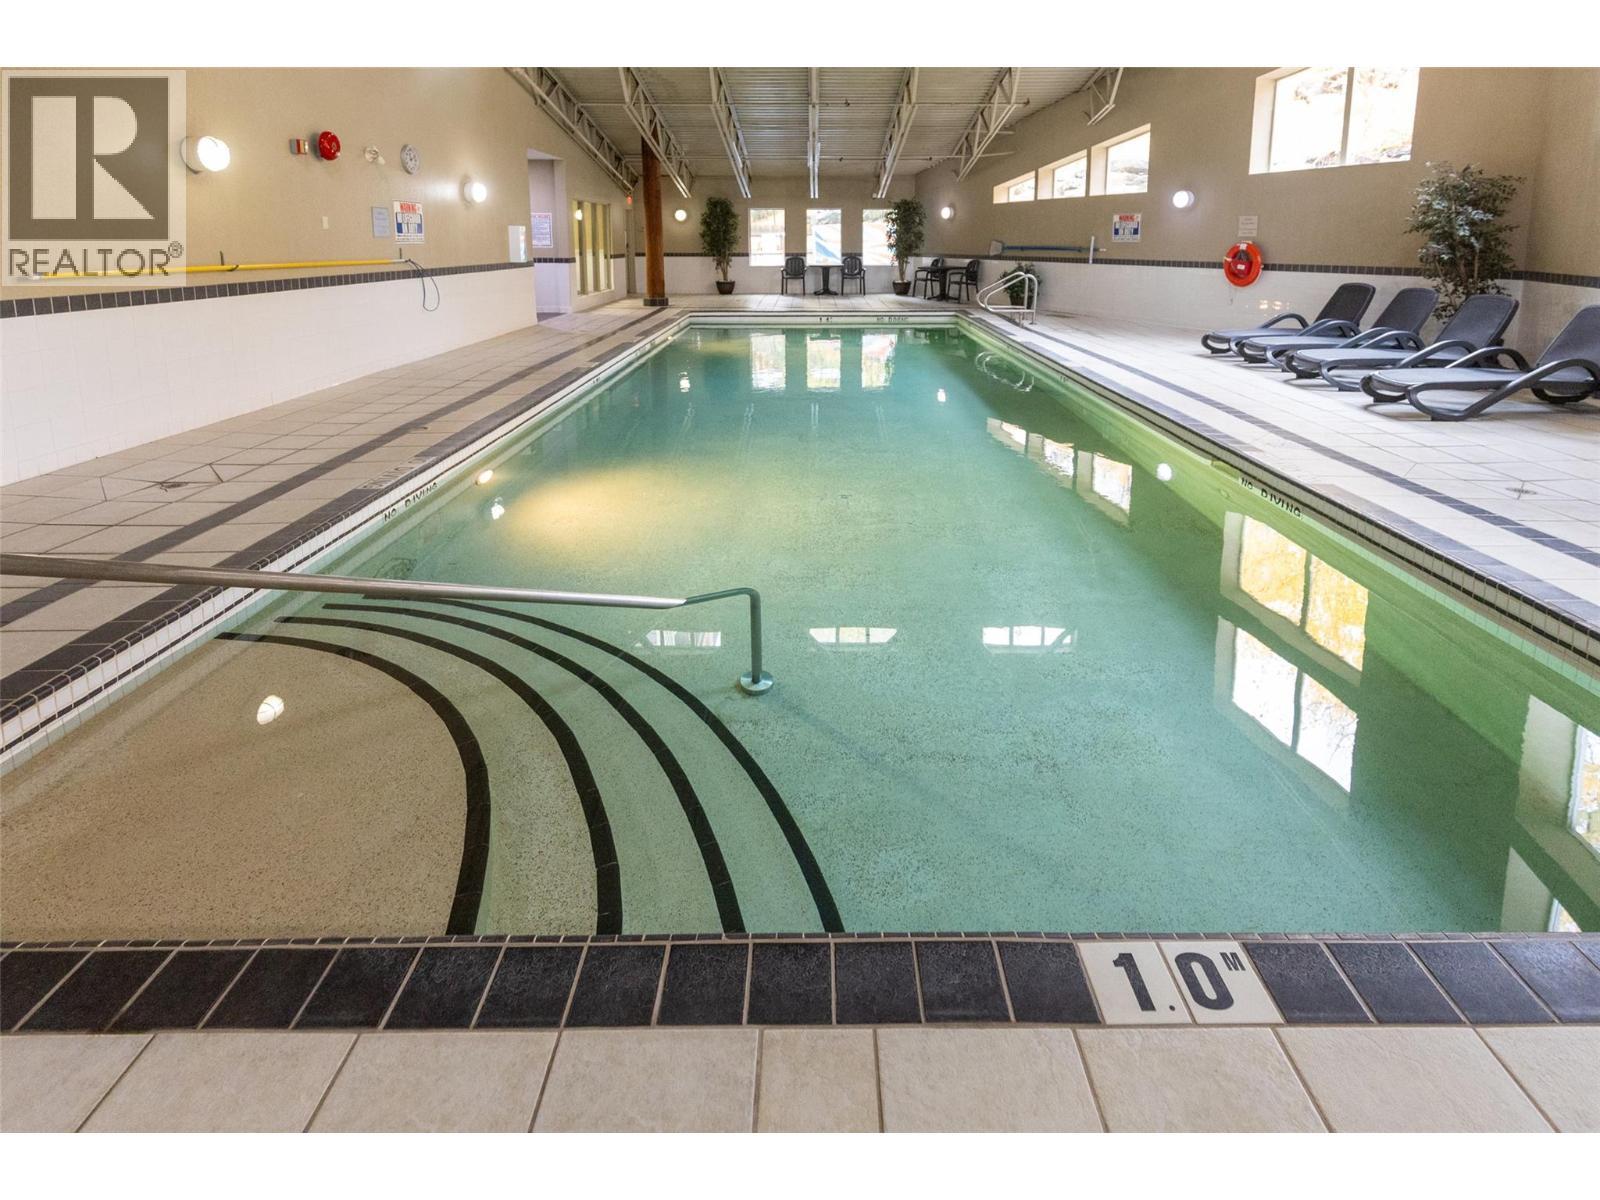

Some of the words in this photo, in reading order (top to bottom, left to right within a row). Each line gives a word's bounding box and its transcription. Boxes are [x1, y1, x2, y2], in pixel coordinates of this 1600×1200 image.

[384, 508, 397, 521] NO
[404, 482, 438, 508] DIVING
[1241, 477, 1253, 490] NO
[1260, 488, 1301, 517] DIVING
